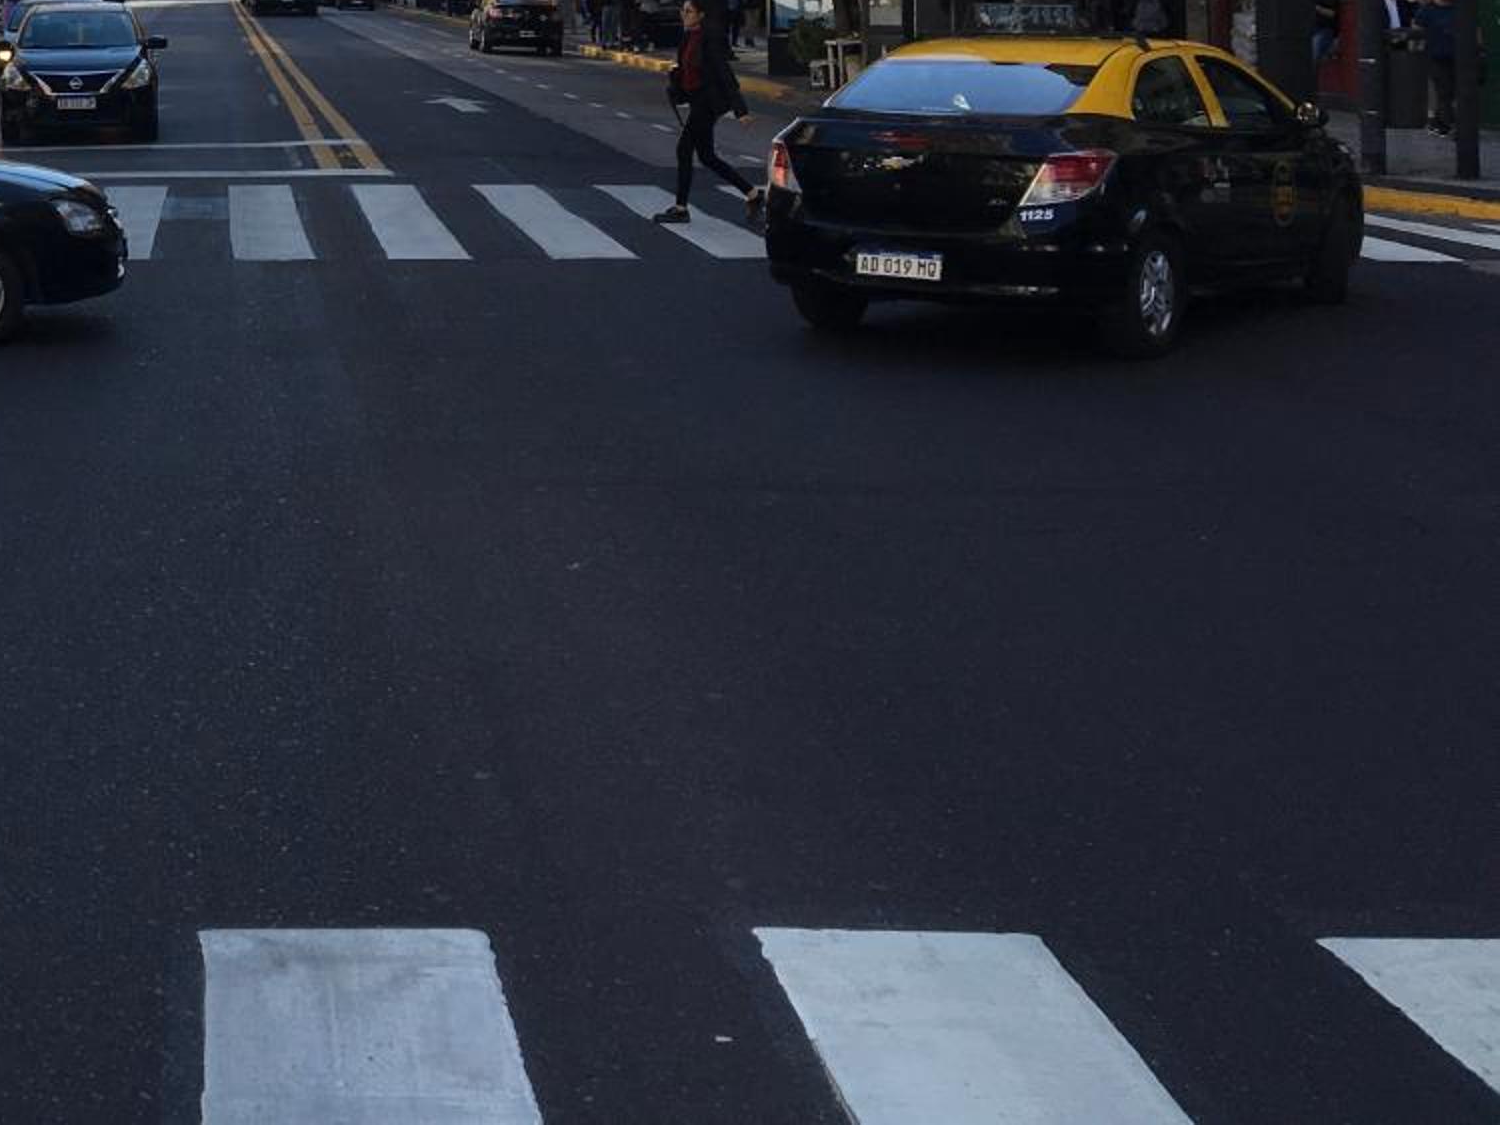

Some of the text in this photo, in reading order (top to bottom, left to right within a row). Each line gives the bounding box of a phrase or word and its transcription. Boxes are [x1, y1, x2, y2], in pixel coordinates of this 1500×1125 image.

[1019, 209, 1054, 222] 1125
[860, 256, 938, 277] AD 019 MQ
